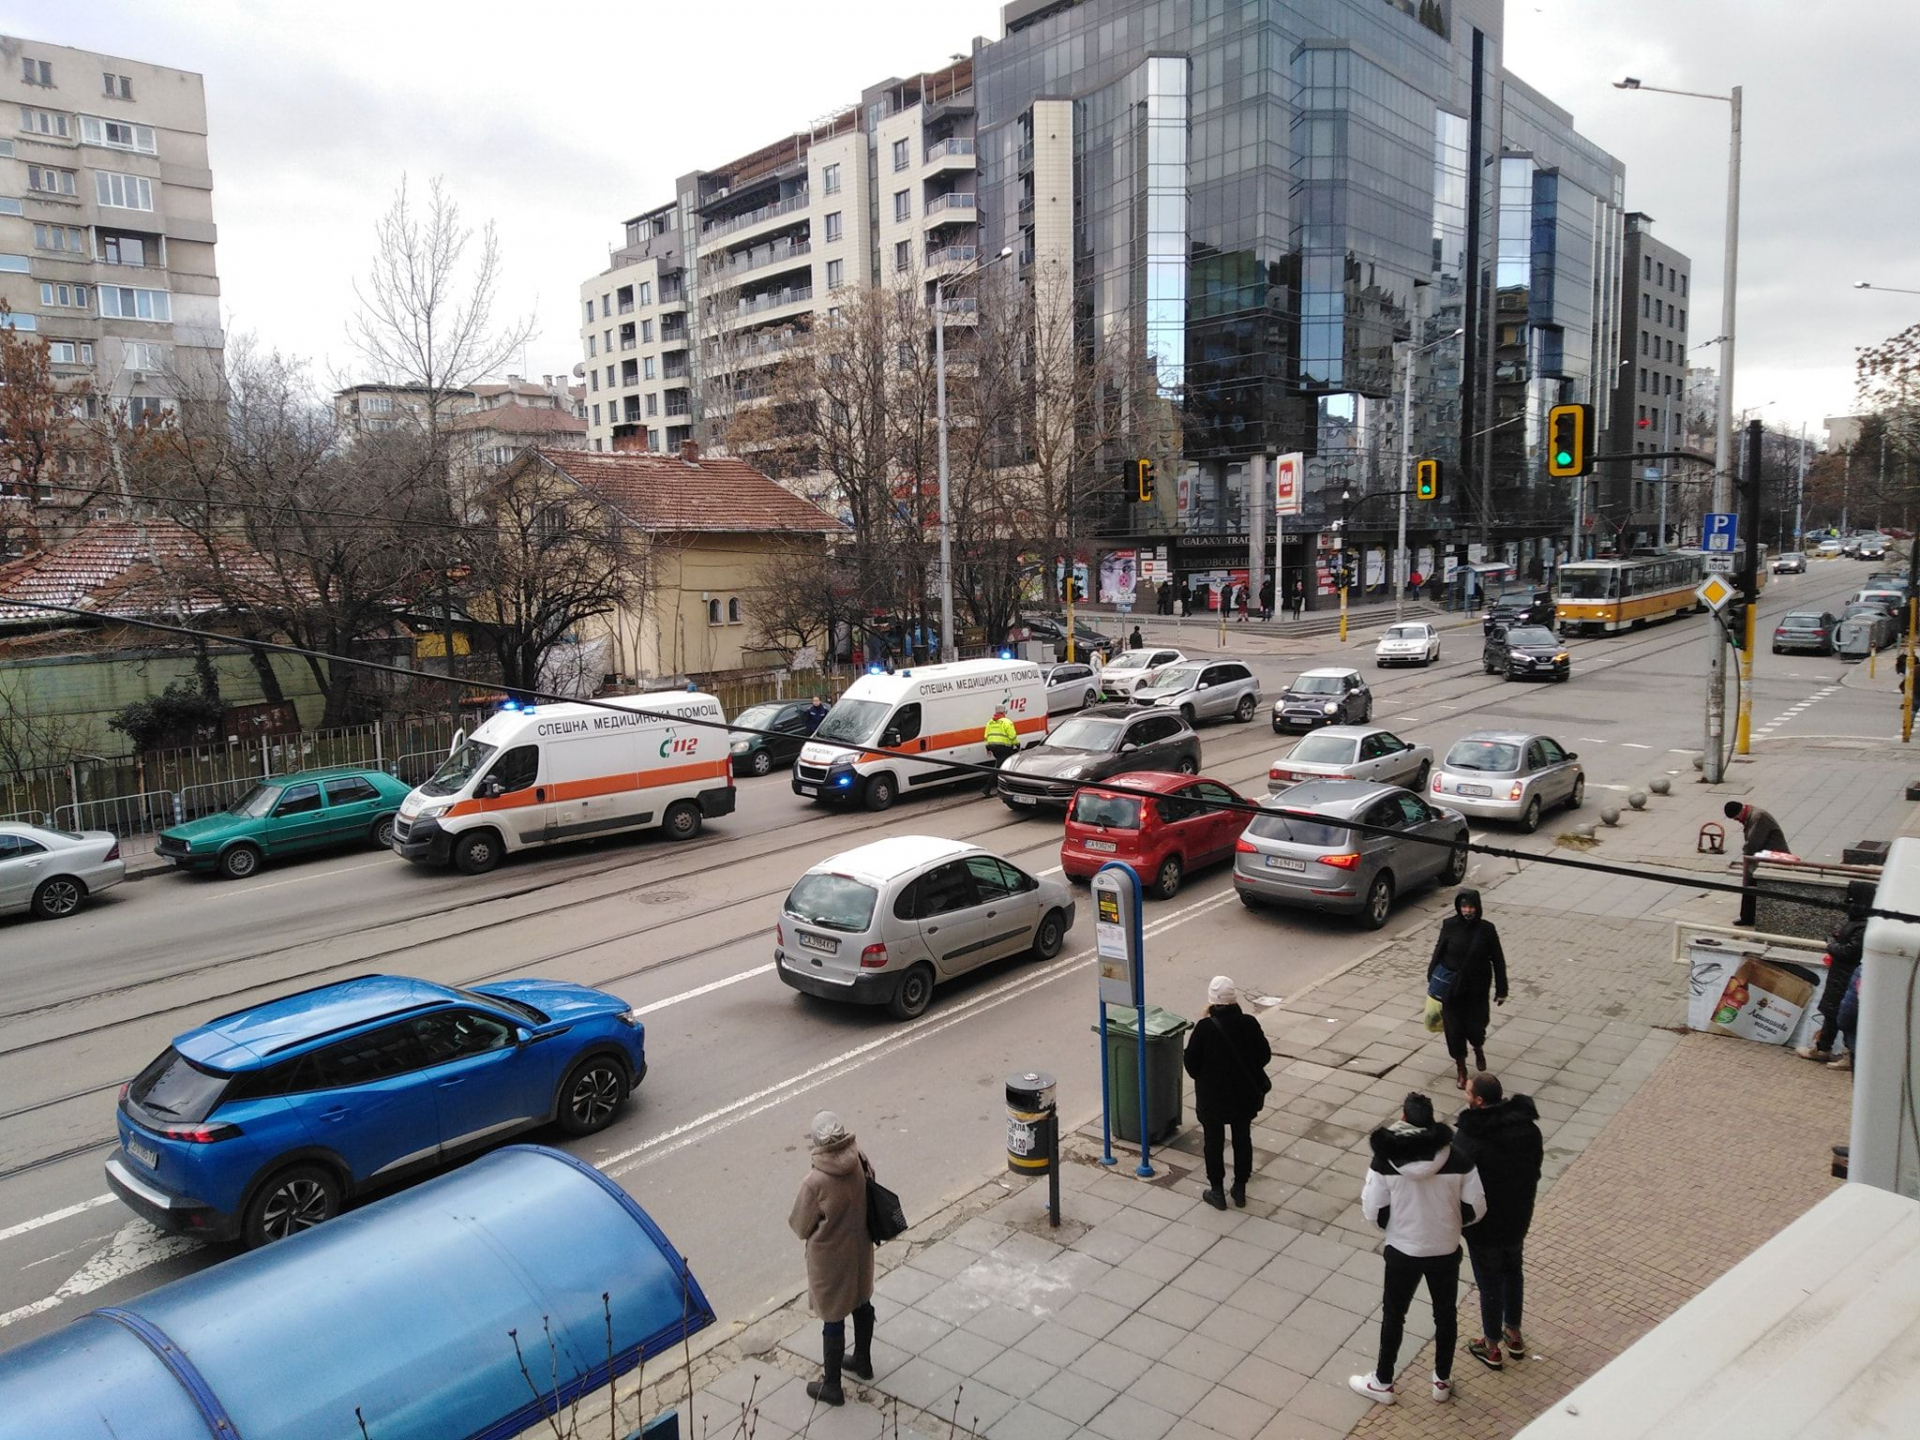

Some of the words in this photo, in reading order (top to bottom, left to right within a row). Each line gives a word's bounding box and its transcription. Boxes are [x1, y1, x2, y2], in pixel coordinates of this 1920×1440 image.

[1714, 515, 1729, 533] P
[1182, 537, 1220, 546] GALAXY
[1226, 536, 1250, 545] TRAD
[920, 682, 954, 696] СПЕШНА
[956, 674, 1009, 690] МЕДИЦИНСКА
[1012, 669, 1040, 681] ПОМОЩ
[1010, 697, 1027, 710] 112
[537, 717, 589, 737] СПЕШНА
[594, 710, 671, 731] МЕДИЦИНСКА
[677, 703, 719, 719] ПОМОЩ
[672, 737, 699, 752] 112
